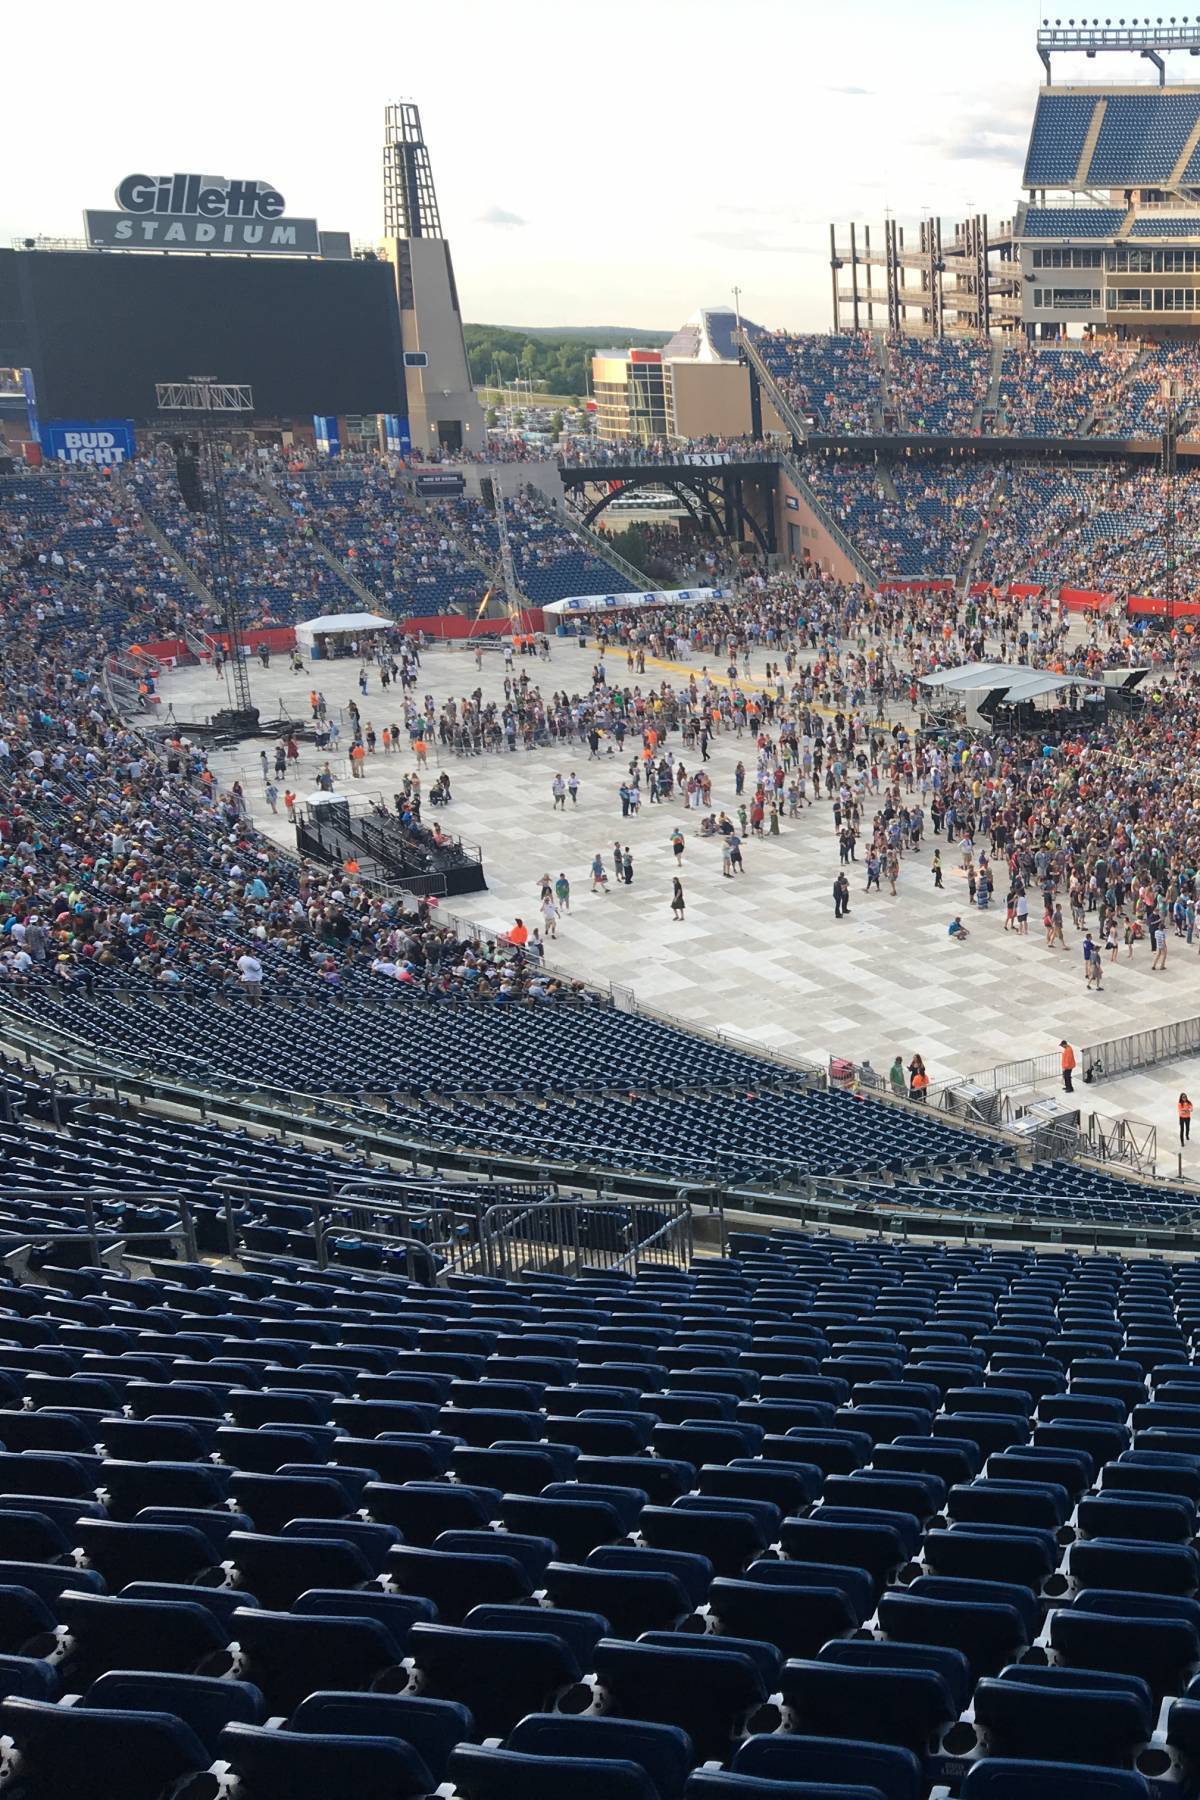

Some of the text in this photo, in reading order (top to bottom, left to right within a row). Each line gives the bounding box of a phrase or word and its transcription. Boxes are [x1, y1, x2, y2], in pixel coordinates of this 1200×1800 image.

[117, 173, 285, 219] Gillette
[114, 220, 296, 244] STADIUM
[64, 432, 115, 448] BUD
[57, 447, 125, 464] LIGHT
[688, 455, 726, 465] EXIT
